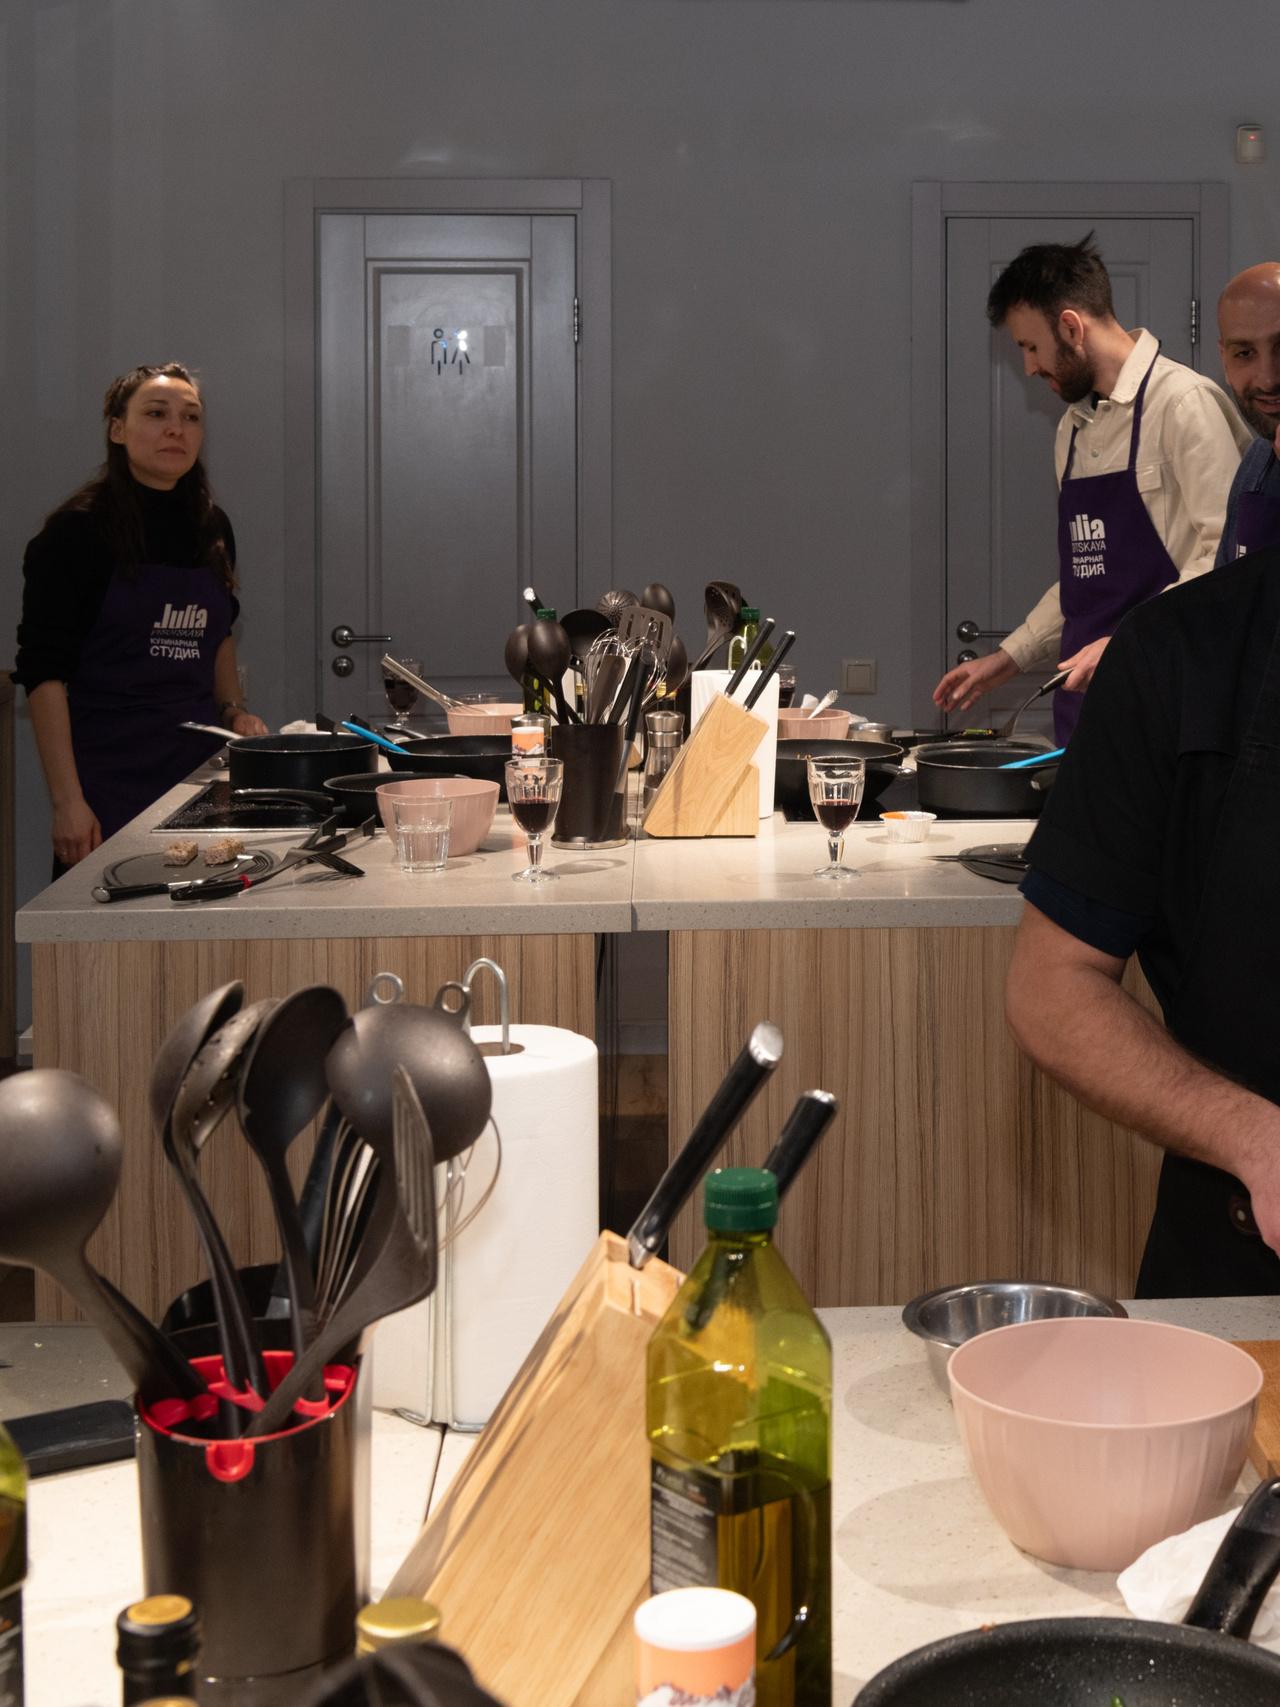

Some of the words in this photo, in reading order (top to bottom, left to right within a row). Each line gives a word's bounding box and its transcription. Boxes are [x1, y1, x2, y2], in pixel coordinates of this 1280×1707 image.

[1069, 513, 1106, 541] ulia
[153, 603, 208, 629] Julia
[149, 637, 199, 648] КУЛИНАРНАЯ
[149, 645, 200, 661] СТУДИЯ
